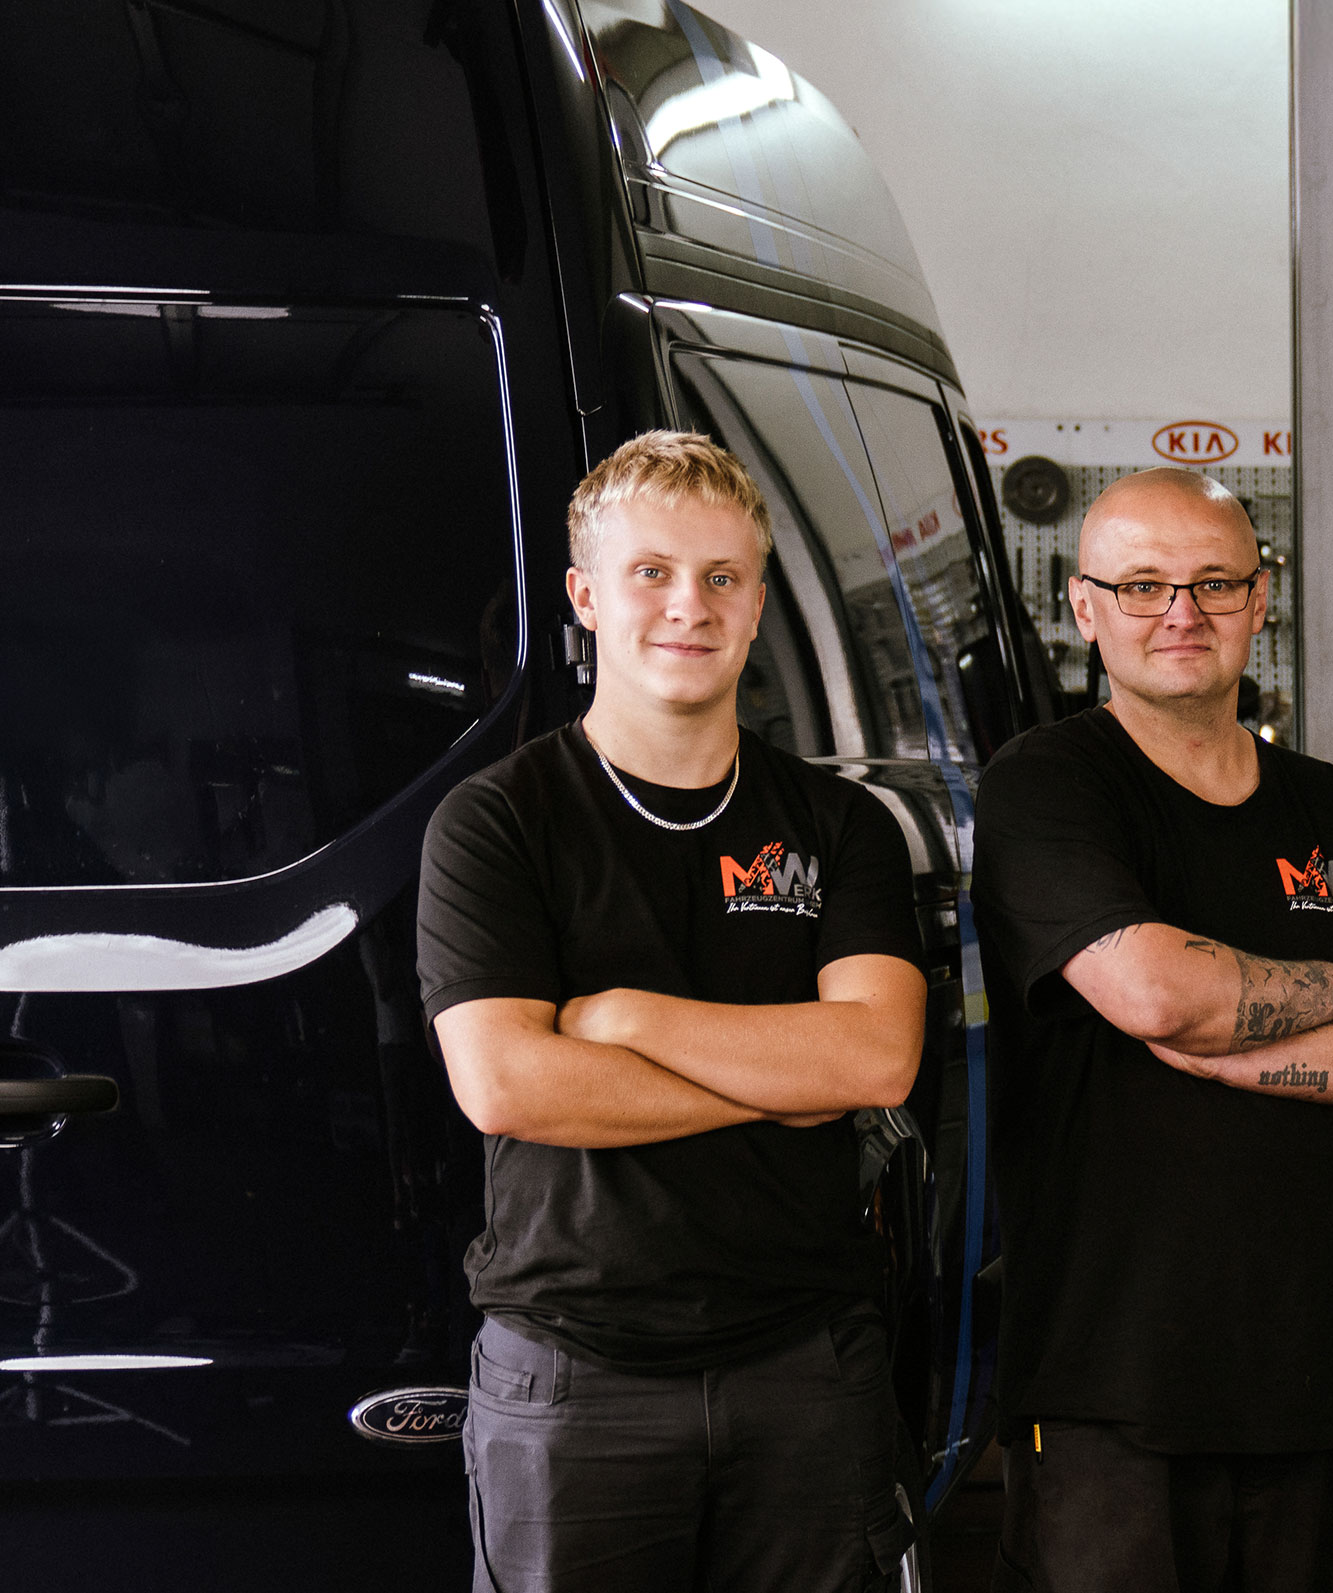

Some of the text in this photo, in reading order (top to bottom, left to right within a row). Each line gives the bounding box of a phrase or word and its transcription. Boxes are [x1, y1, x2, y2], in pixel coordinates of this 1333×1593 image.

[1168, 431, 1225, 454] KIA
[1258, 1062, 1329, 1093] nothing
[385, 1399, 468, 1433] Ford
